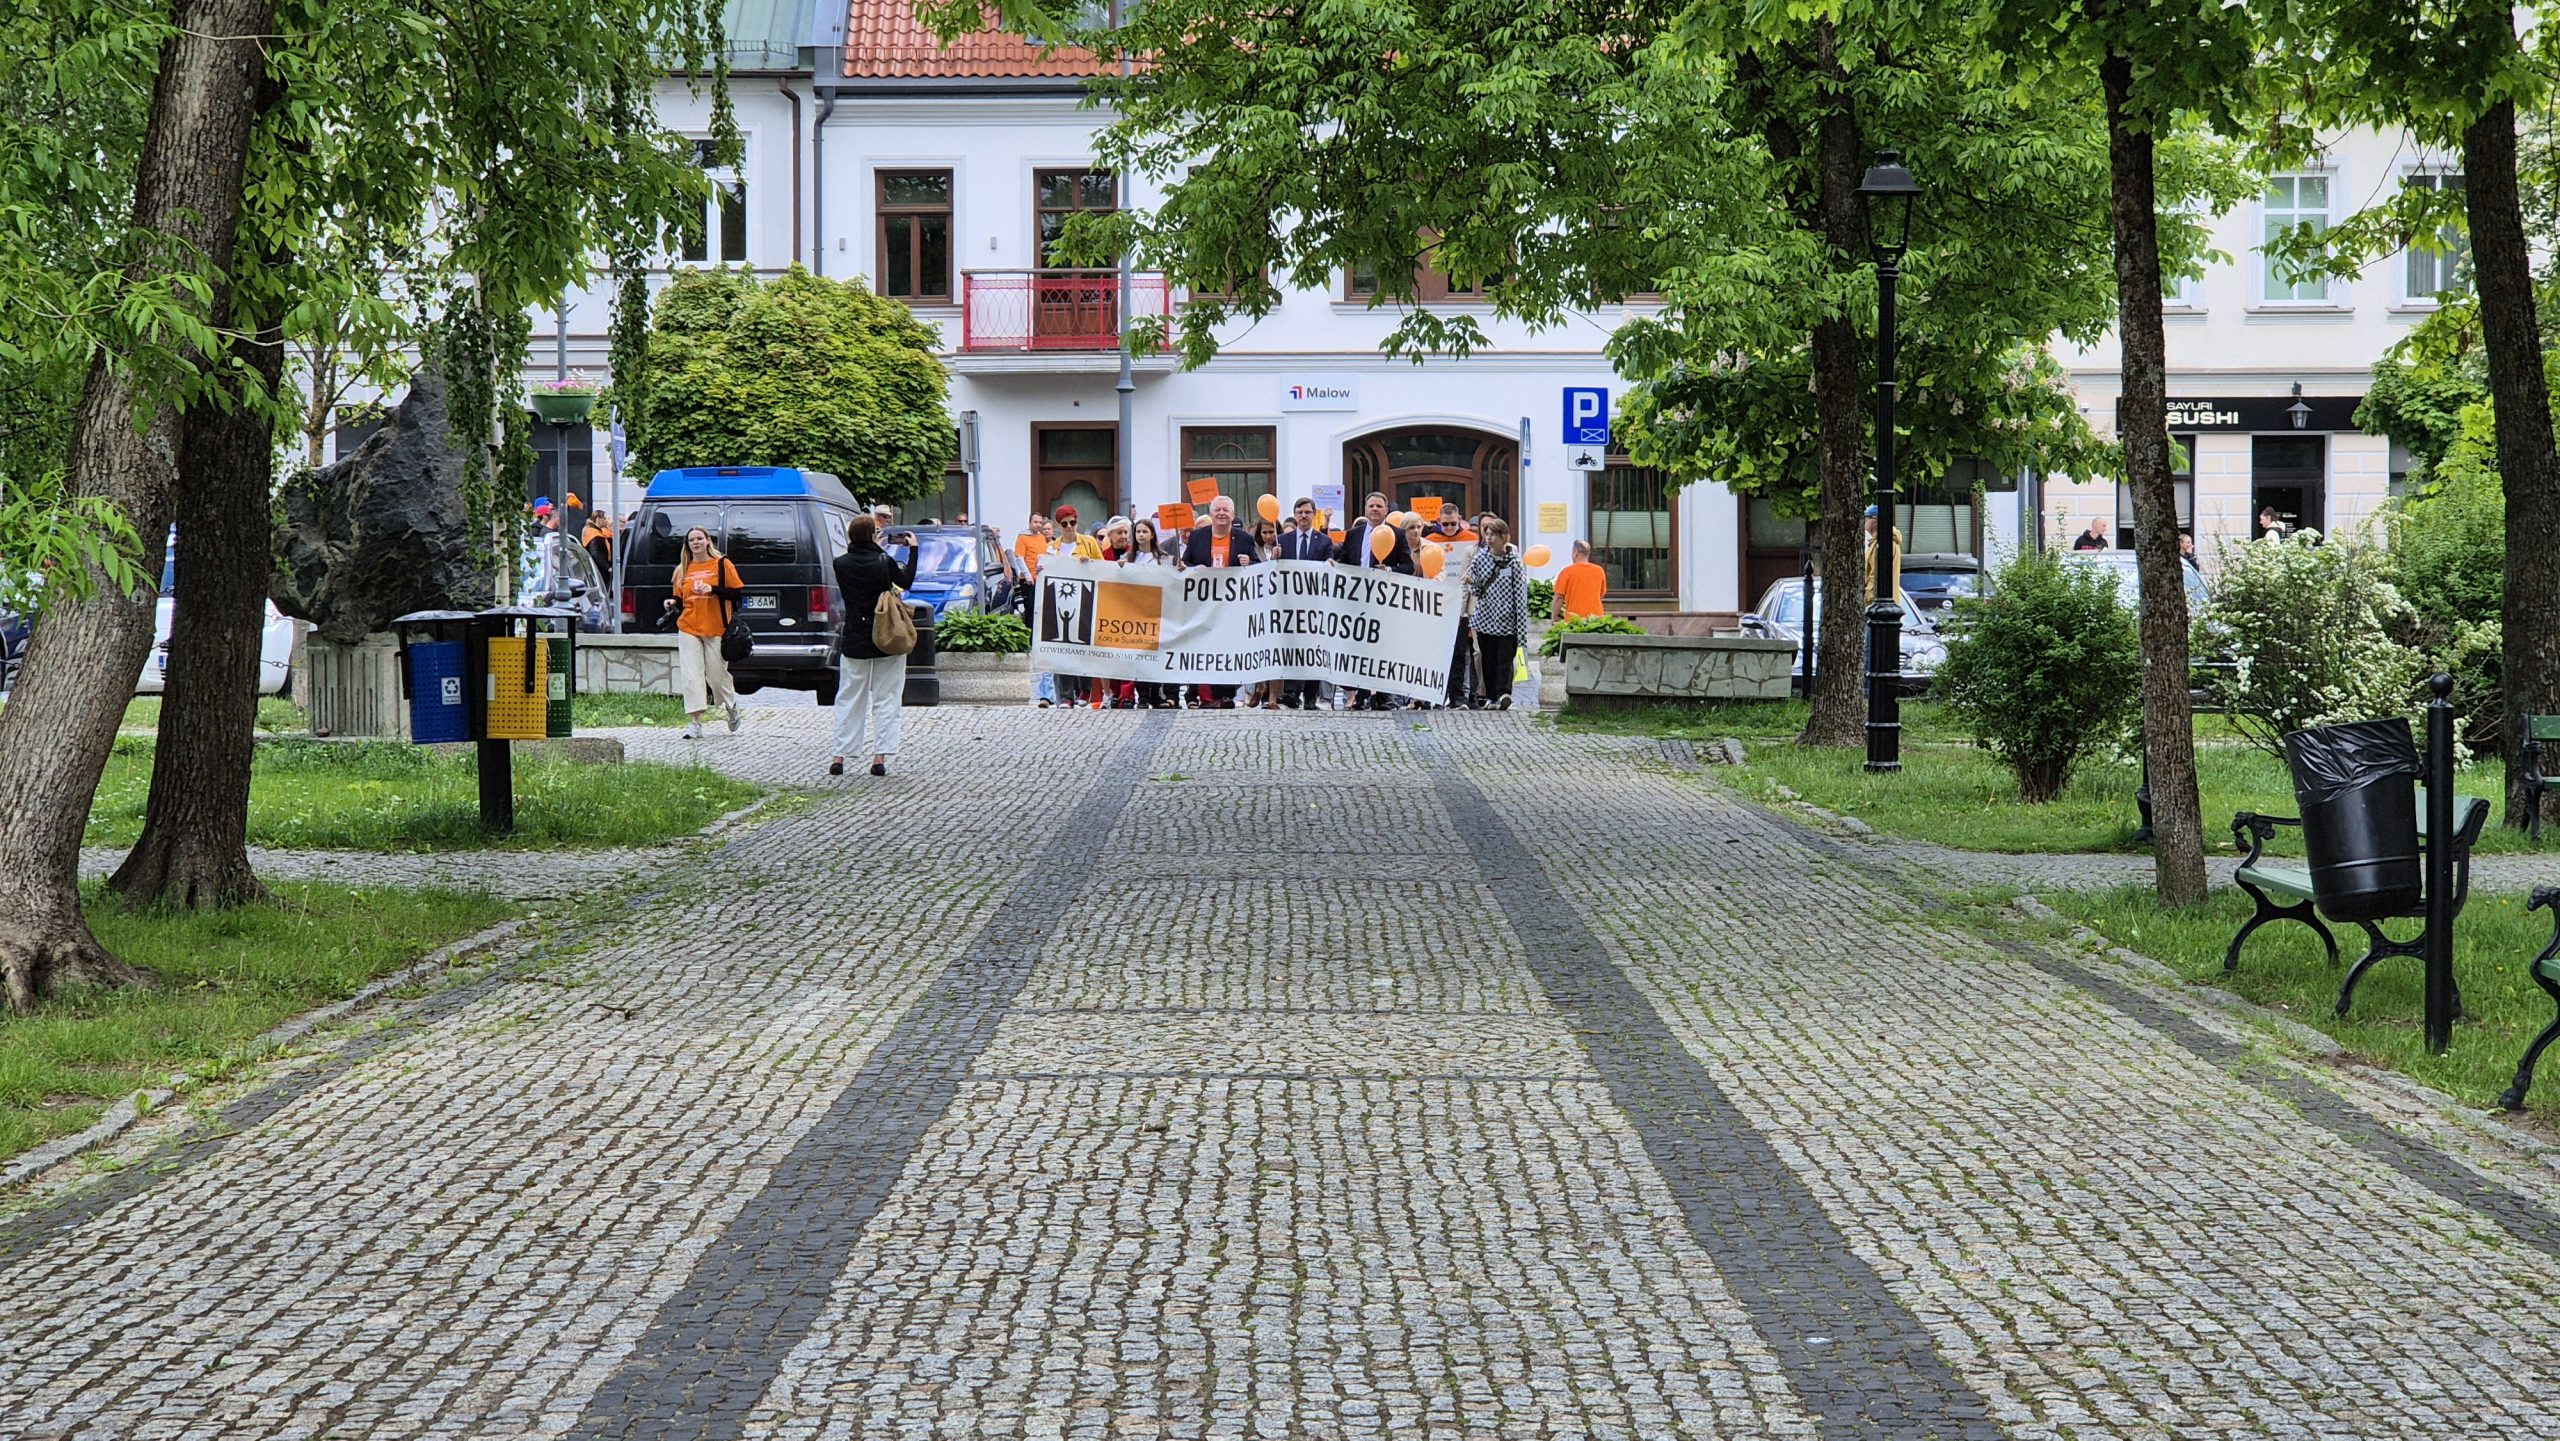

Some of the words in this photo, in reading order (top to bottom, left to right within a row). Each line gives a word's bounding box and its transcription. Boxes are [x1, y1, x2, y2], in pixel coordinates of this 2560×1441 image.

[1306, 387, 1350, 398] Malow
[1572, 391, 1600, 428] P
[2166, 402, 2213, 410] SAYURI
[2167, 411, 2239, 424] SUSHI
[1183, 574, 1264, 602] POLSKIE
[1268, 570, 1444, 617] STOWARZYSZENIE
[1097, 618, 1158, 637] PSONI
[1247, 612, 1265, 638] NA
[1270, 609, 1326, 635] RZECZ
[1327, 612, 1381, 644] OSÓB
[1039, 646, 1087, 657] OTWIERAMY
[1088, 650, 1114, 659] PRZED
[1165, 651, 1175, 670] Z
[1179, 644, 1332, 675] NIEPEŁNOSPRAWNOŚCĄ
[1334, 652, 1445, 694] INTELEKTUALNĄ
